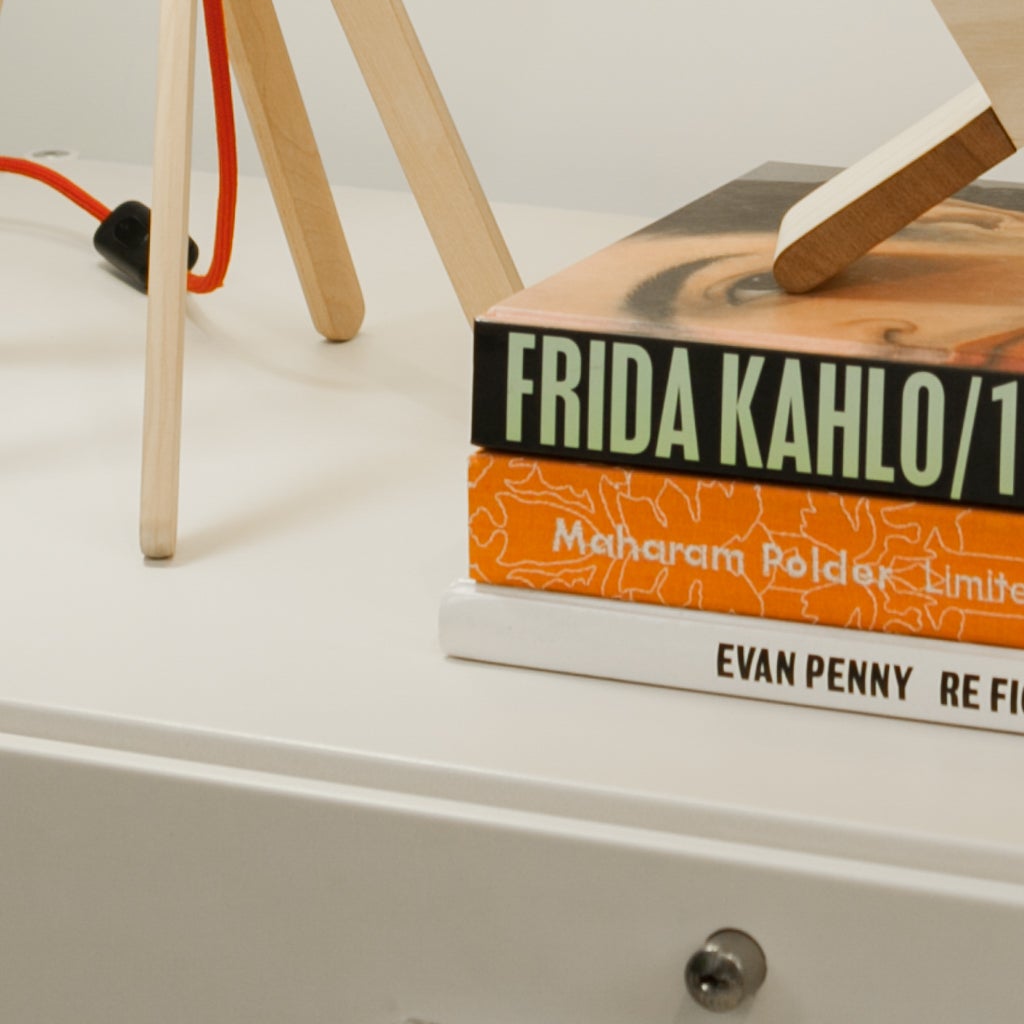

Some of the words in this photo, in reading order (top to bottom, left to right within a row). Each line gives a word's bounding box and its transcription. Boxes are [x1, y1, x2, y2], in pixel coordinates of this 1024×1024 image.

[505, 332, 700, 462] FRIDA
[552, 517, 744, 577] Maharam
[762, 542, 894, 590] Polder
[716, 642, 796, 687] EVAN
[806, 654, 914, 702] PENNY
[939, 670, 980, 711] RE
